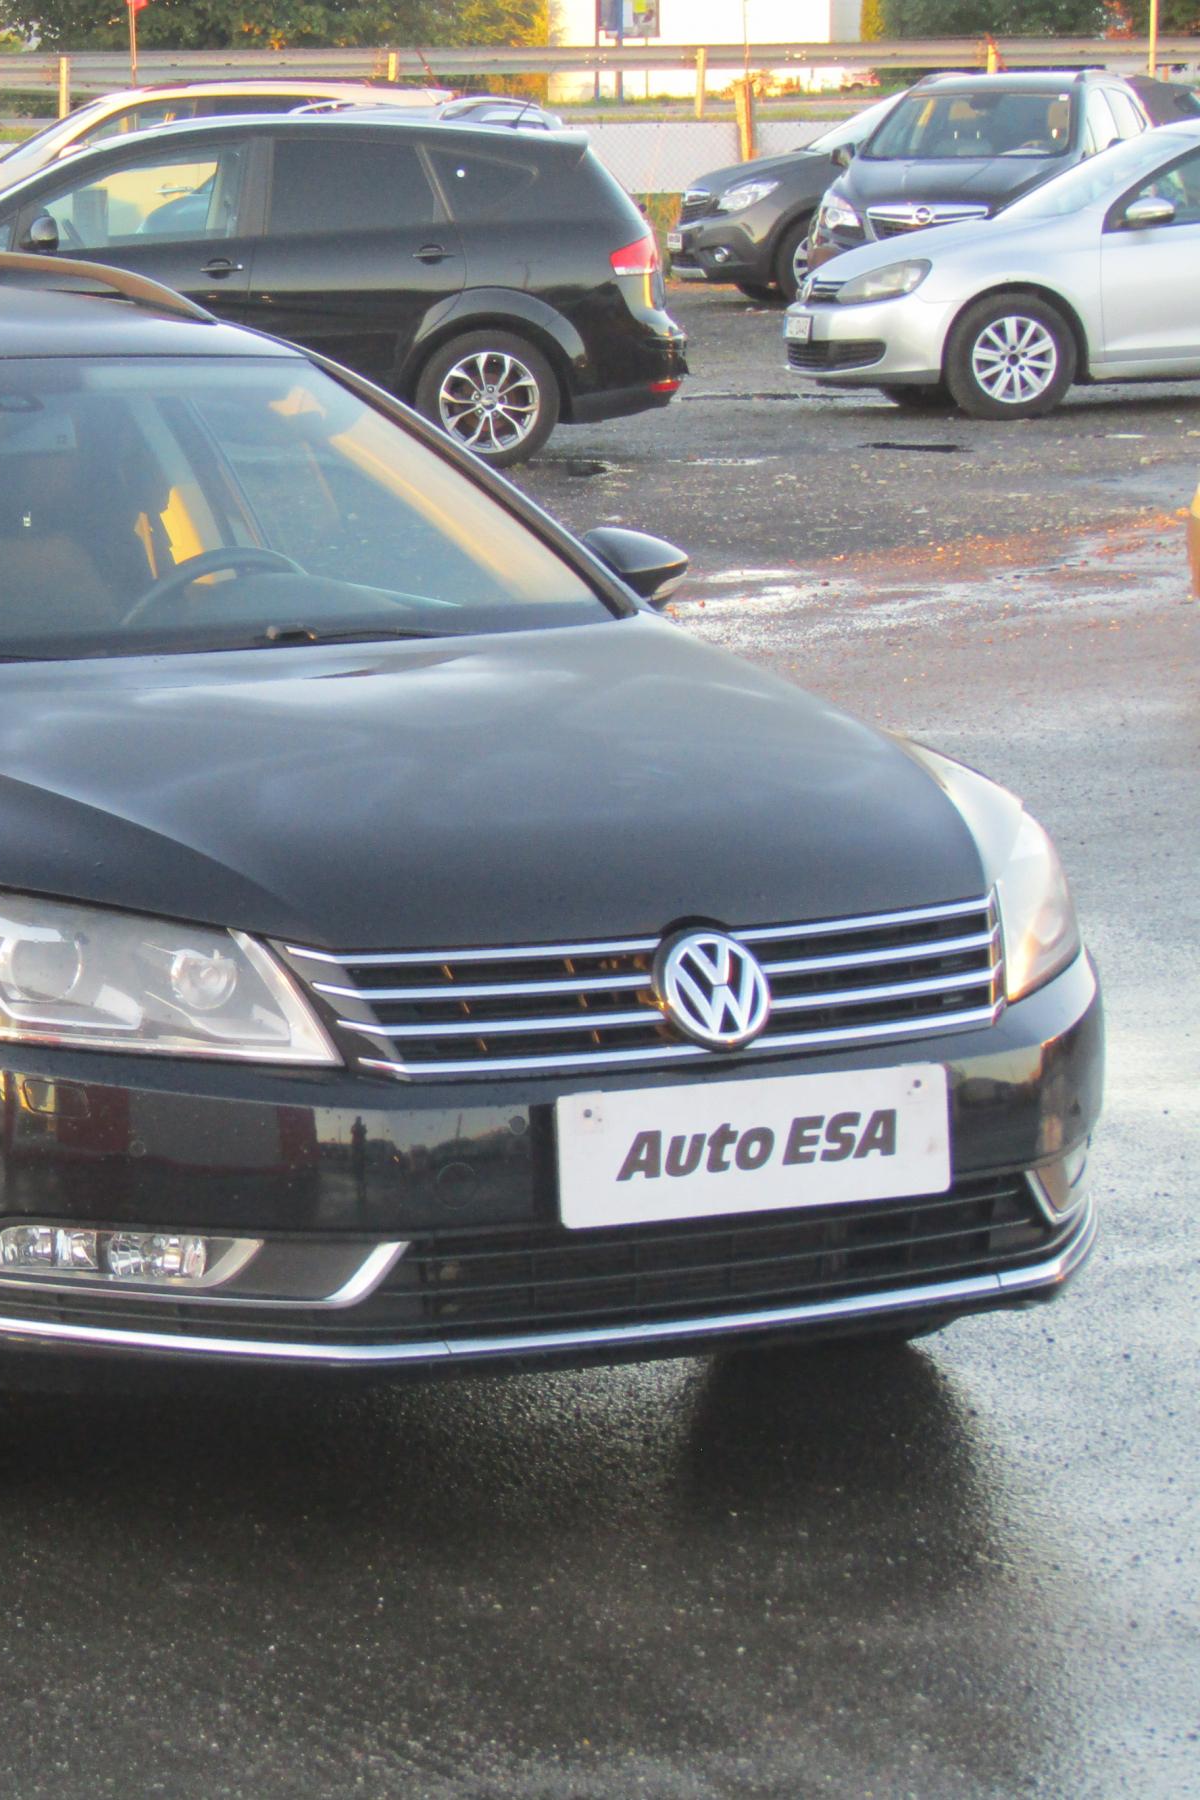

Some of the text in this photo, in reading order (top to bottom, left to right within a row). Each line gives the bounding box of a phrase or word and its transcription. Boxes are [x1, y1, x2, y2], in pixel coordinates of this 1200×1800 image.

[665, 933, 769, 1041] VW
[616, 1109, 896, 1181] Auto ESA
